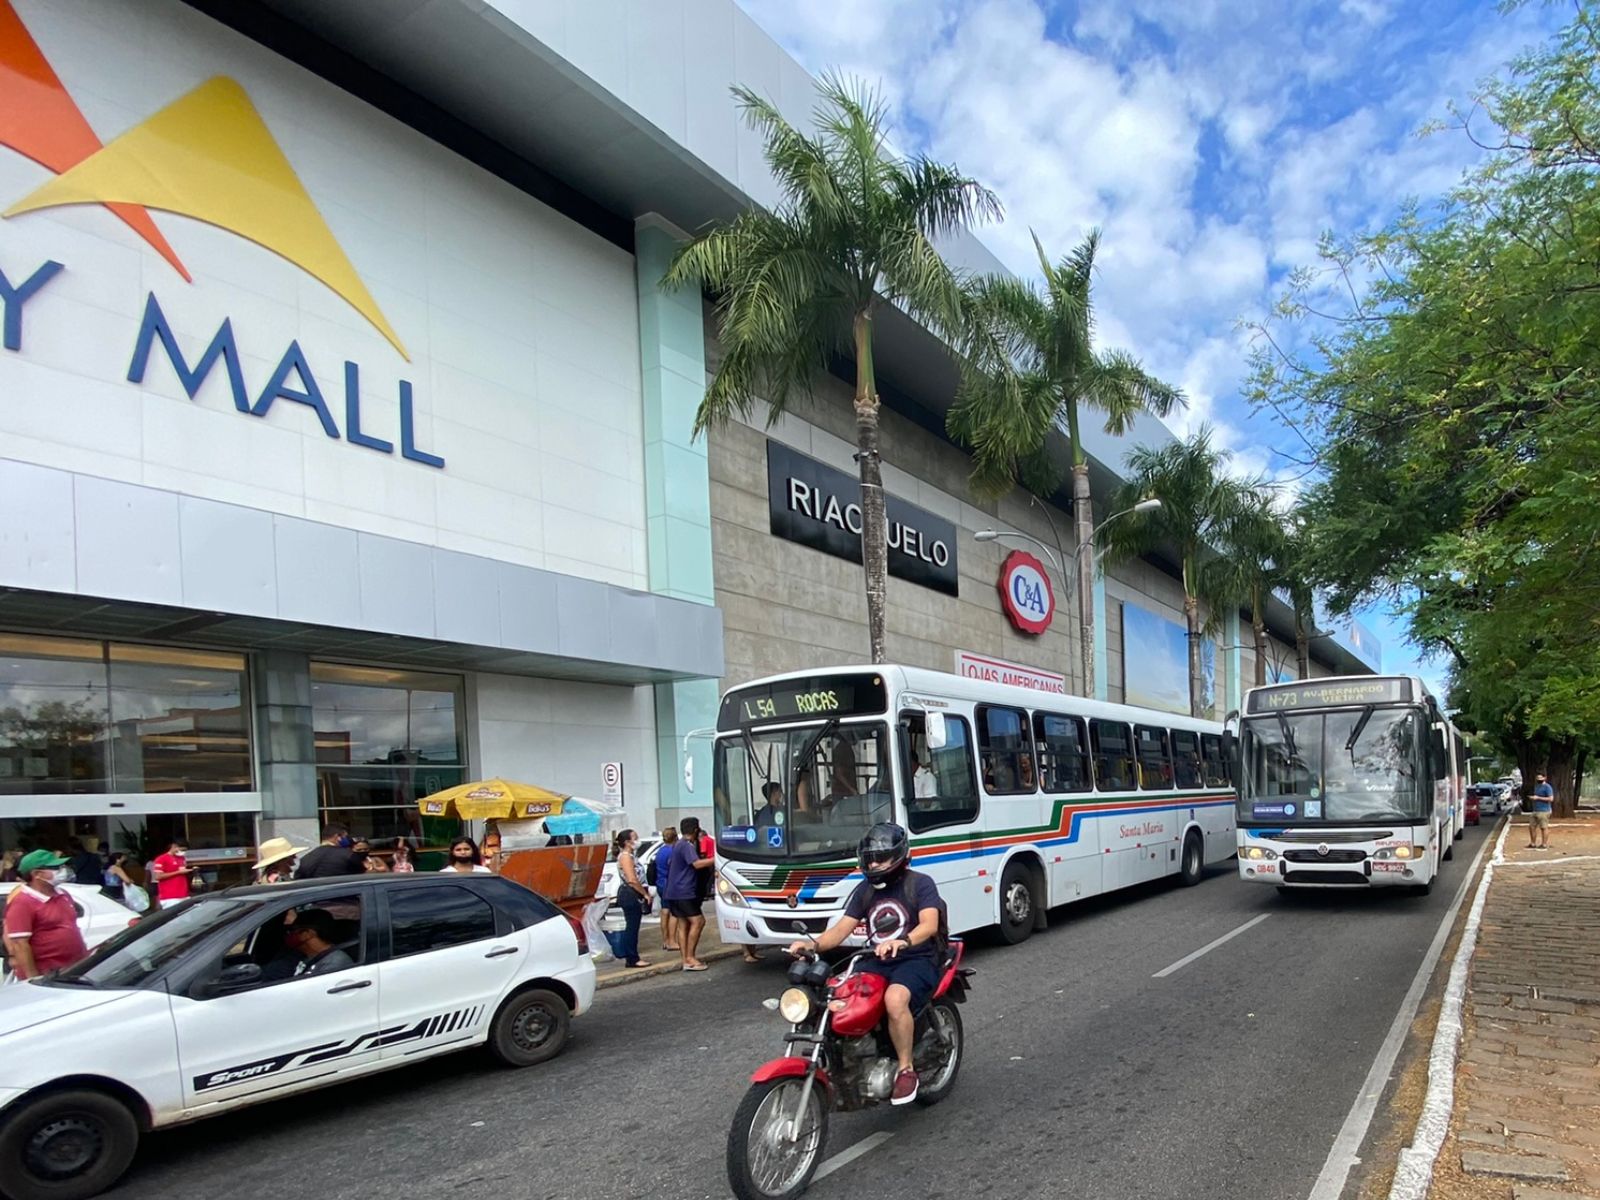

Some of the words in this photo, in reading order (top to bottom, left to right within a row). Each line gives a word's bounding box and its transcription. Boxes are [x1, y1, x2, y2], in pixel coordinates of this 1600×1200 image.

[127, 290, 445, 468] MALL
[787, 477, 949, 568] RIACUELO
[1013, 574, 1046, 615] C&A
[744, 701, 757, 719] L
[795, 690, 839, 713] ROCAS
[1119, 824, 1141, 838] Santa
[1142, 821, 1164, 835] Maria
